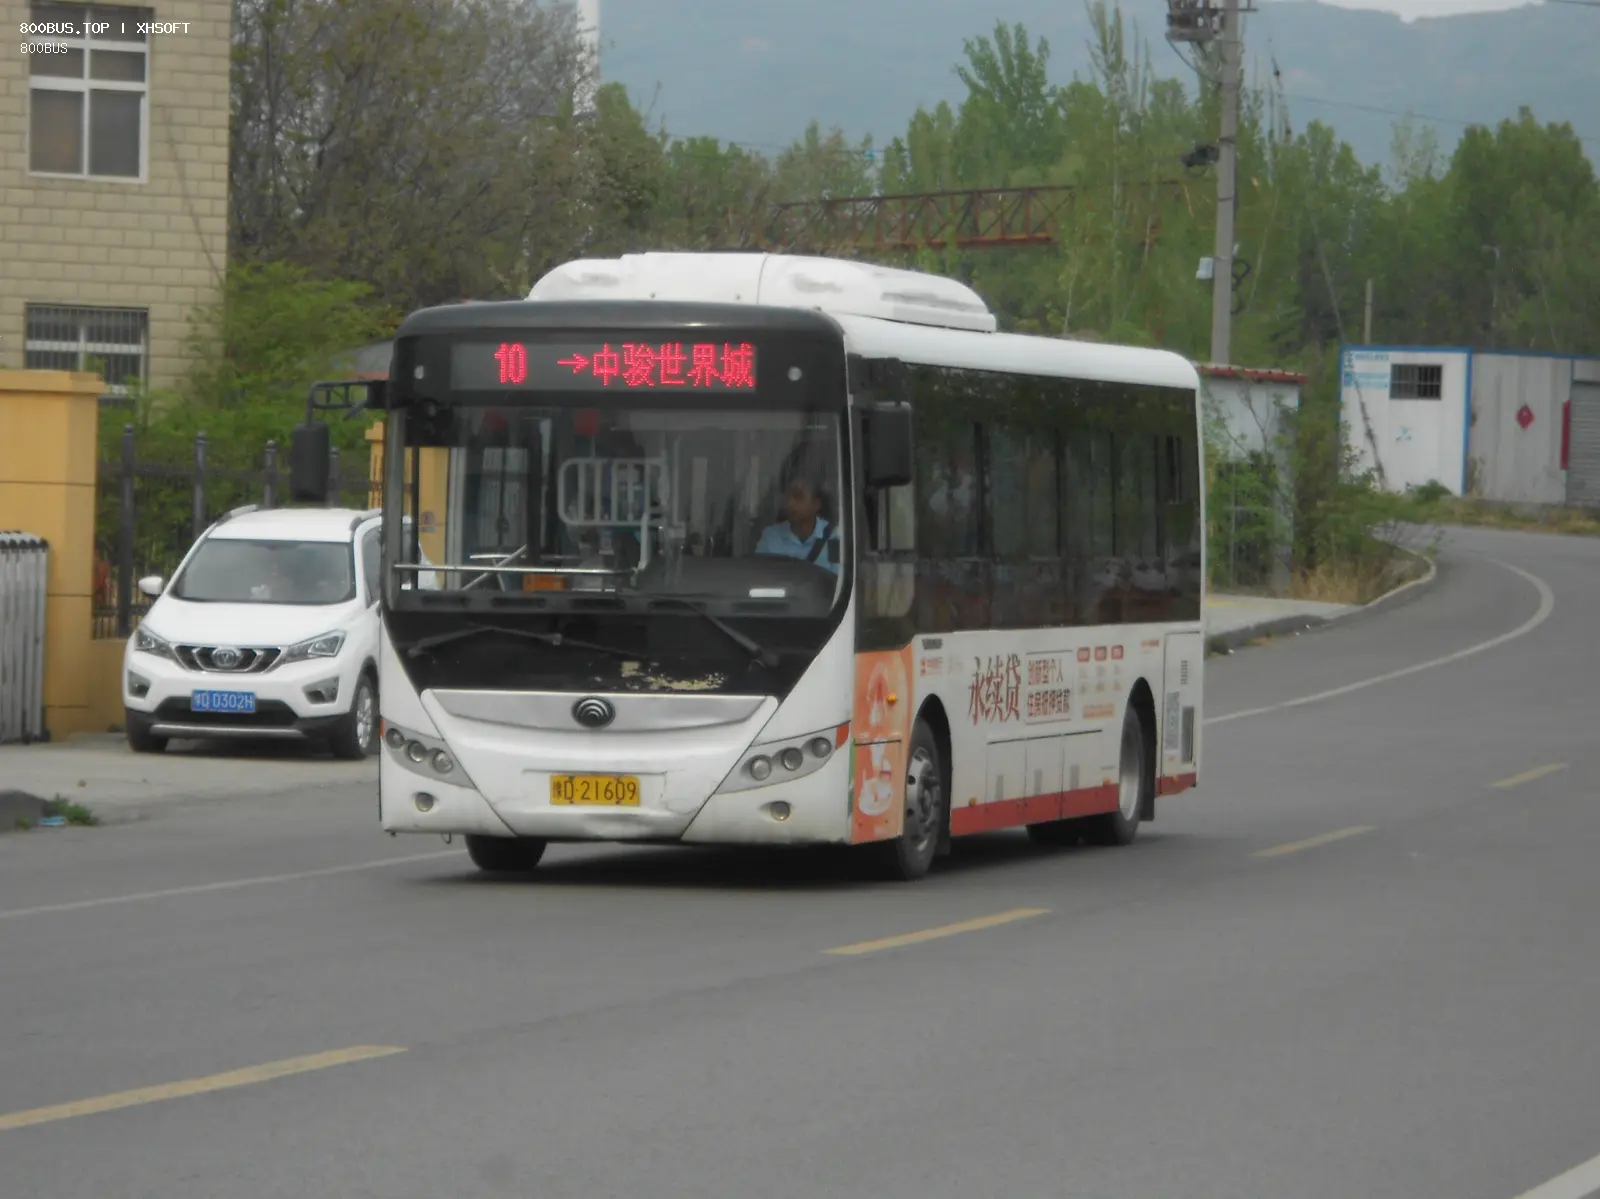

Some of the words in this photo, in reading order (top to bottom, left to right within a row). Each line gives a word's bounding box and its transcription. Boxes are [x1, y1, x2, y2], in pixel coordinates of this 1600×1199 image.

[494, 342, 528, 384] 10
[592, 342, 755, 387] 中骏世界城
[968, 653, 1021, 726] 永续贷
